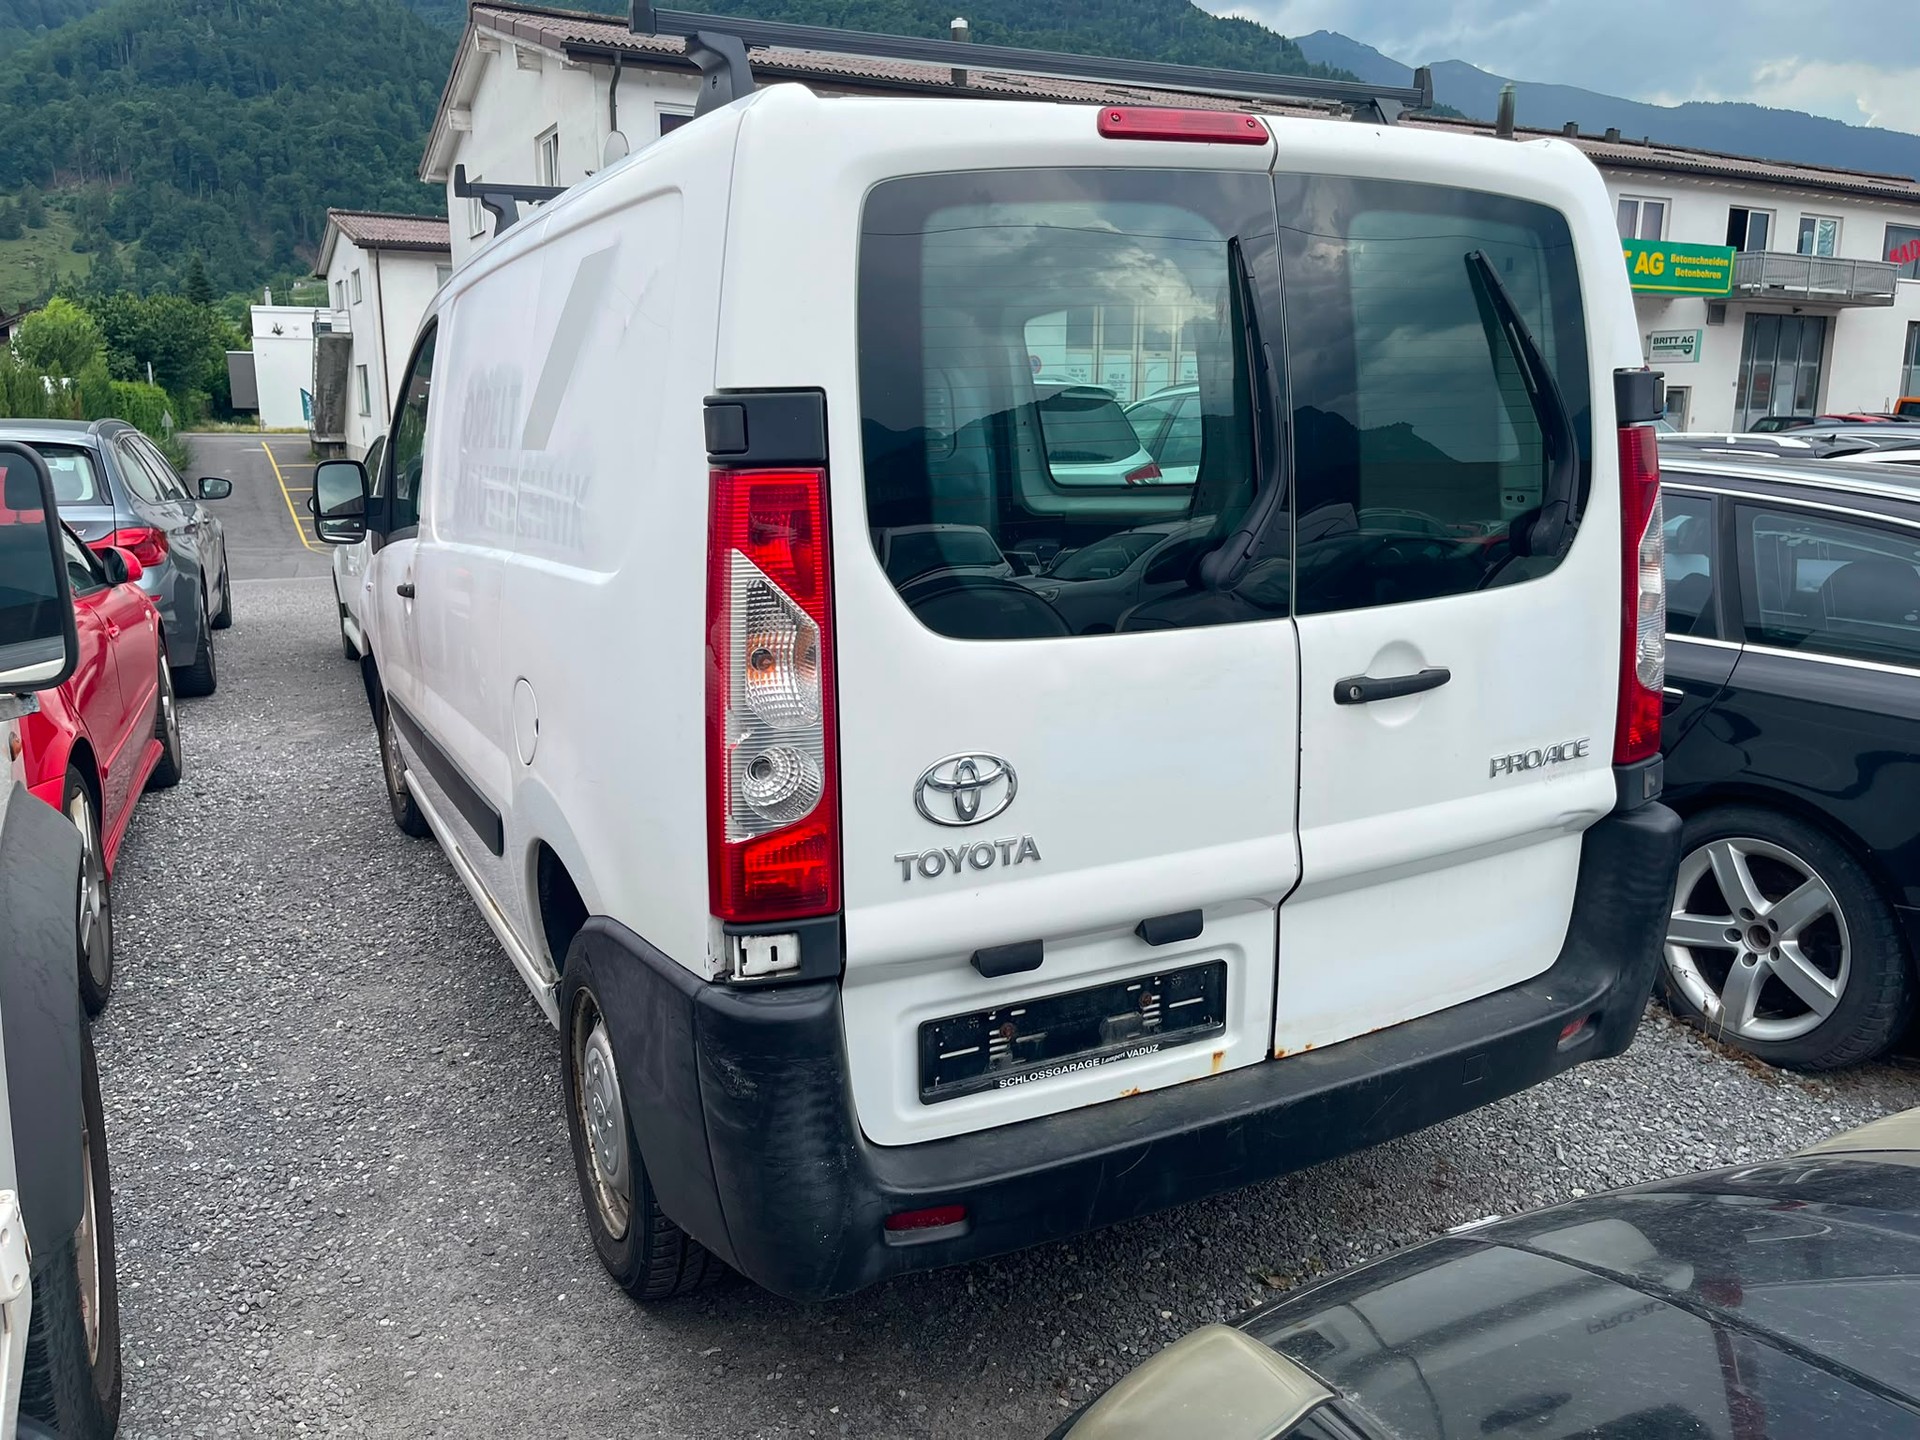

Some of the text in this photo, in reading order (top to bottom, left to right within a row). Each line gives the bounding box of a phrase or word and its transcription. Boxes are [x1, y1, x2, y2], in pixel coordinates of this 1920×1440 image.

[1634, 251, 1665, 275] AG
[1670, 253, 1730, 267] Betonschneiden
[1674, 267, 1722, 280] Betonbohren
[1653, 335, 1695, 345] BRITT AG
[1489, 736, 1590, 778] PROACE
[894, 833, 1042, 881] TOYOTA
[999, 1044, 1159, 1088] SCHLOSSGARAGE Lampert VADUZ
